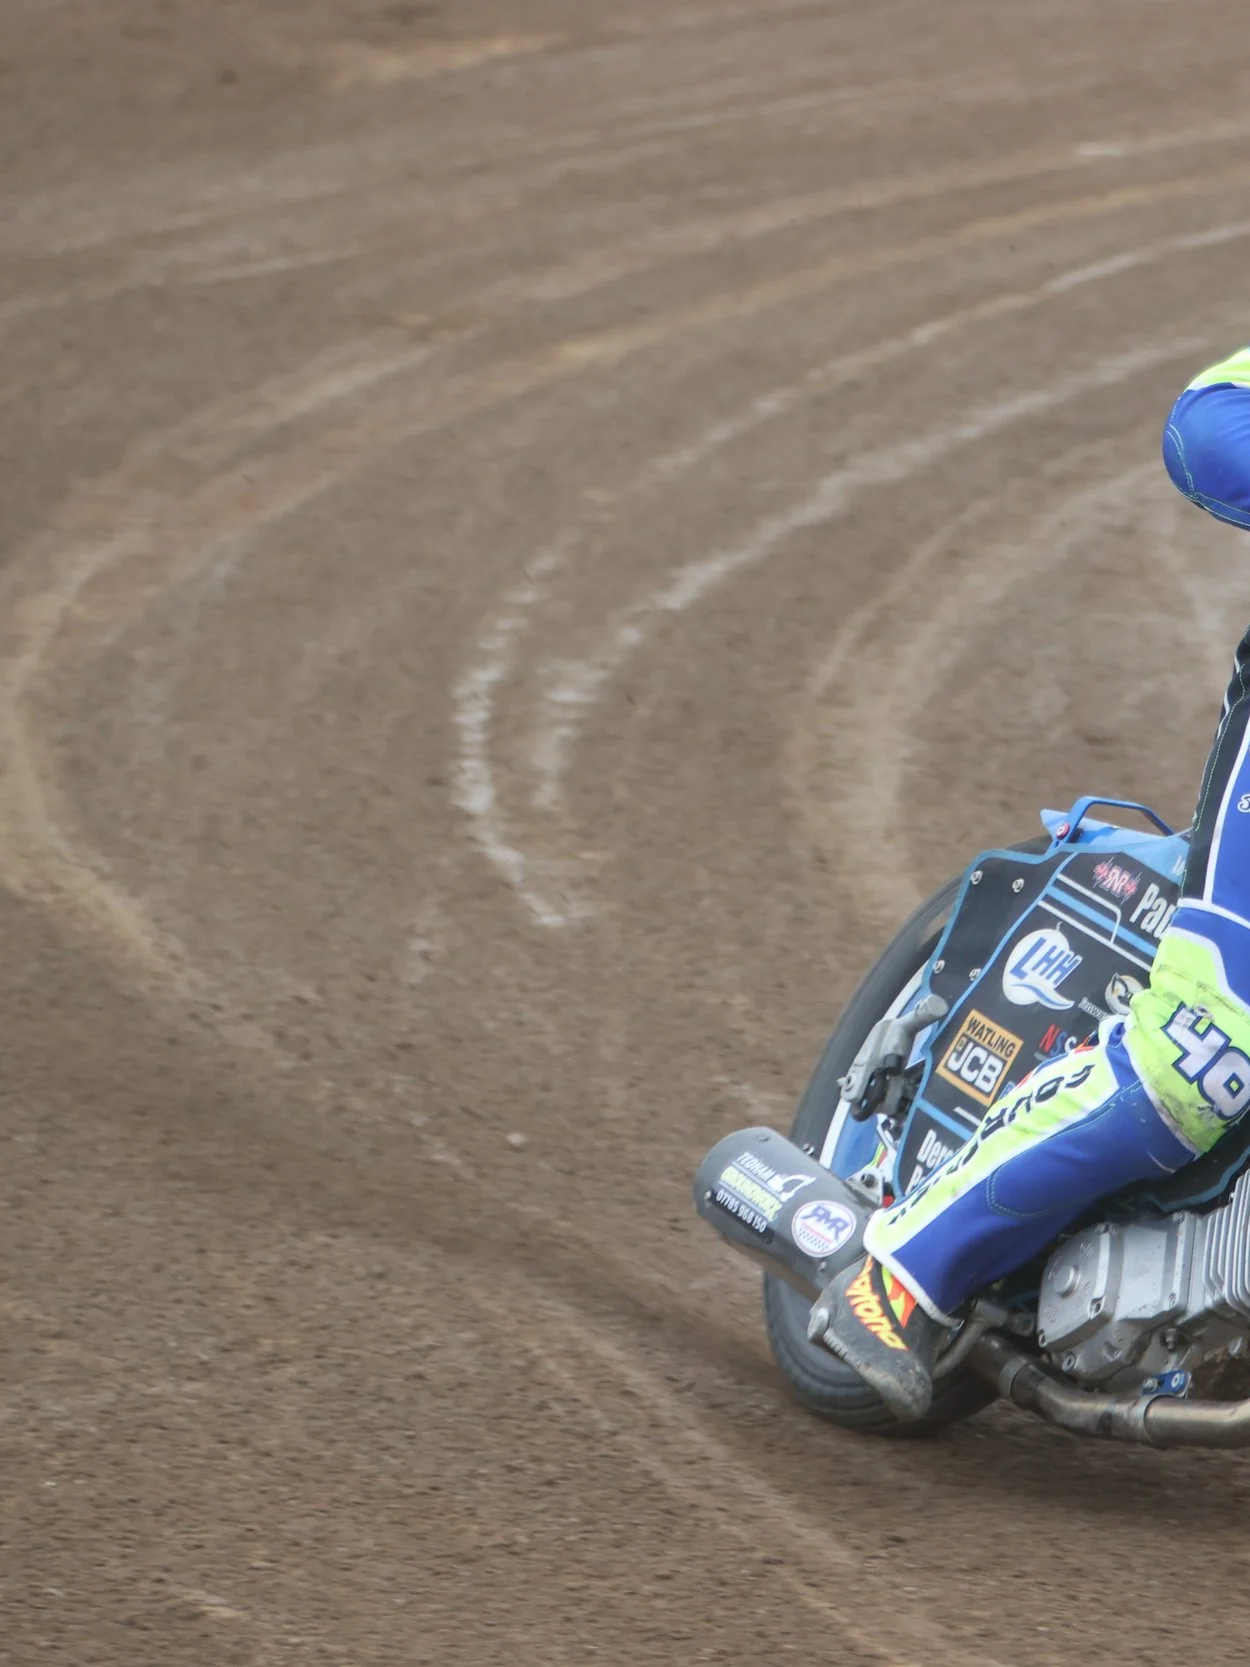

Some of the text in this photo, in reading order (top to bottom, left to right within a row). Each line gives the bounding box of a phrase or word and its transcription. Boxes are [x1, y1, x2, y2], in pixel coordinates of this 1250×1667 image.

[1009, 937, 1083, 988] LHH
[966, 1016, 1016, 1060] WATLING
[946, 1041, 1003, 1094] JCB
